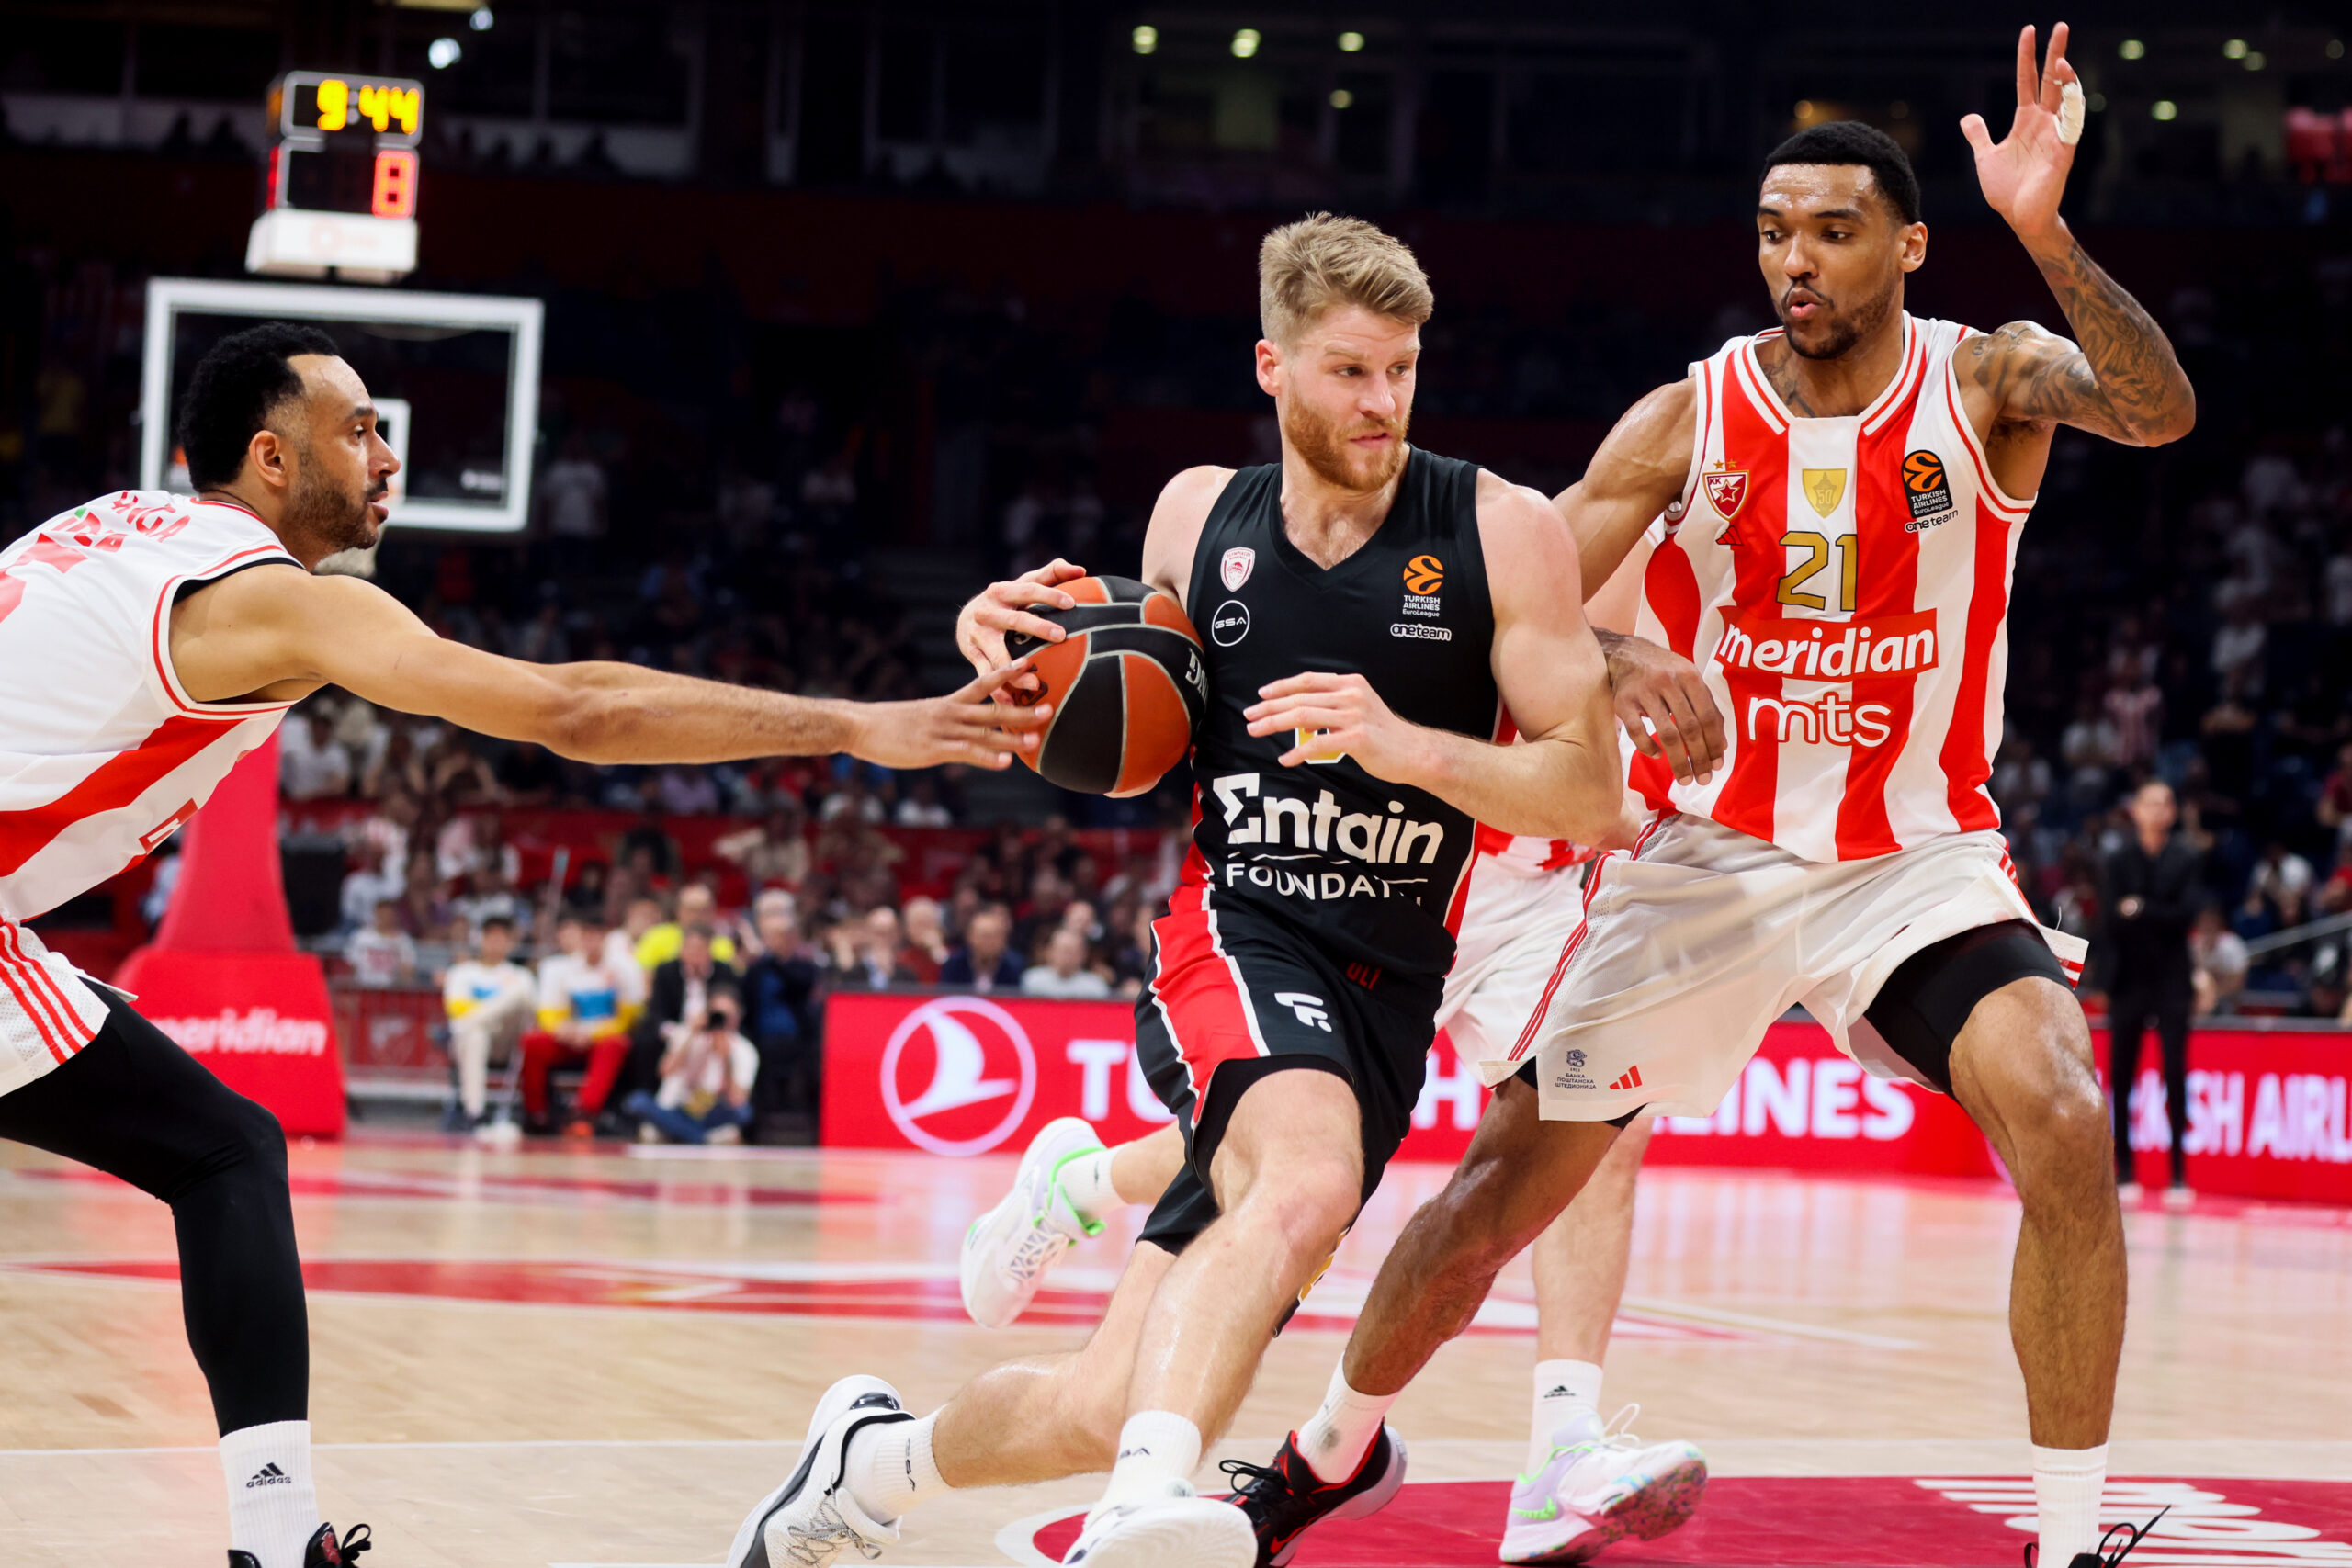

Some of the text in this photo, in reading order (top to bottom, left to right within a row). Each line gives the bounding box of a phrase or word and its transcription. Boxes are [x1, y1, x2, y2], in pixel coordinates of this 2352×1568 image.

[372, 150, 418, 220] 8
[1911, 489, 1947, 503] TURKISH
[1913, 495, 1948, 510] AIRLINES
[1914, 502, 1950, 515] EuroLeague
[1776, 530, 1859, 613] 21
[1403, 594, 1441, 604] TURKISH
[1402, 608, 1441, 618] EuroLeague
[1403, 602, 1441, 612] AIRLINES
[1215, 616, 1247, 629] GSA
[1719, 623, 1935, 677] meridian
[1747, 695, 1892, 748] mts
[245, 1476, 292, 1488] adidas
